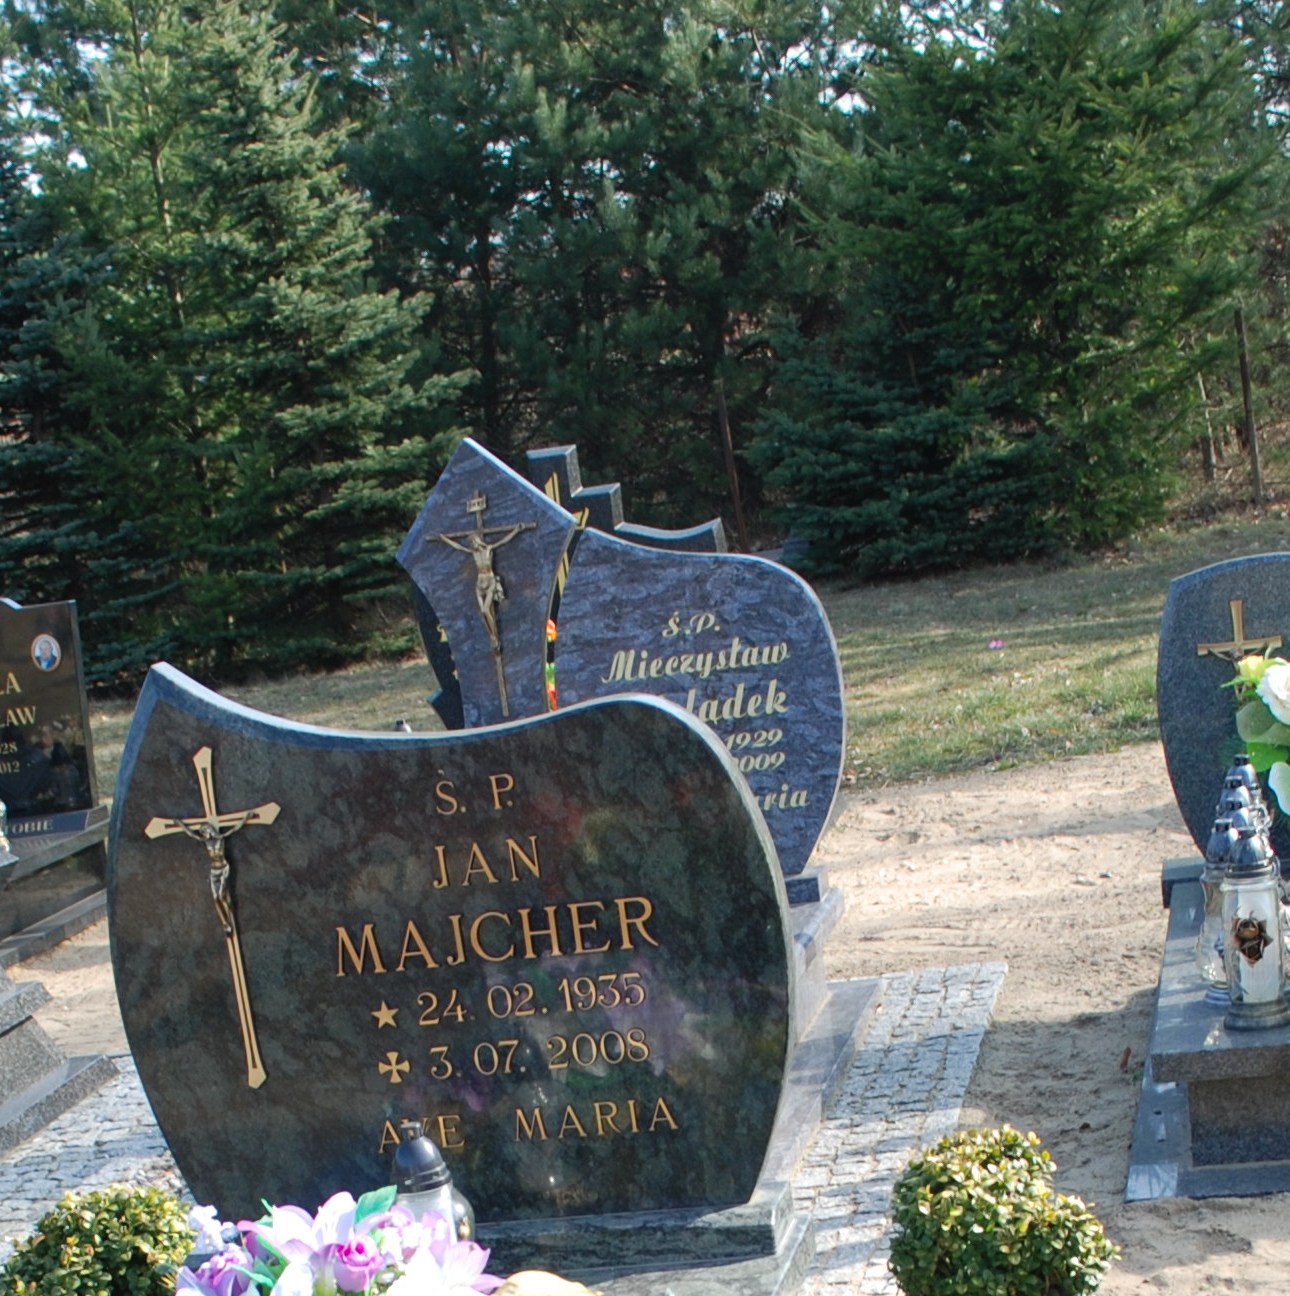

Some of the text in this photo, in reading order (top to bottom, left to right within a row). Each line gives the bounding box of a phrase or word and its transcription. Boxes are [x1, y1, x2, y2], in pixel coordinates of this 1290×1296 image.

[601, 636, 791, 684] Mieczysław
[686, 678, 790, 725] lądek
[724, 728, 783, 751] 1929
[732, 752, 785, 772] 009
[754, 783, 811, 811] ria
[432, 835, 542, 889] JAN
[335, 896, 659, 978] MAJCHER
[515, 1097, 679, 1143] MARIA
